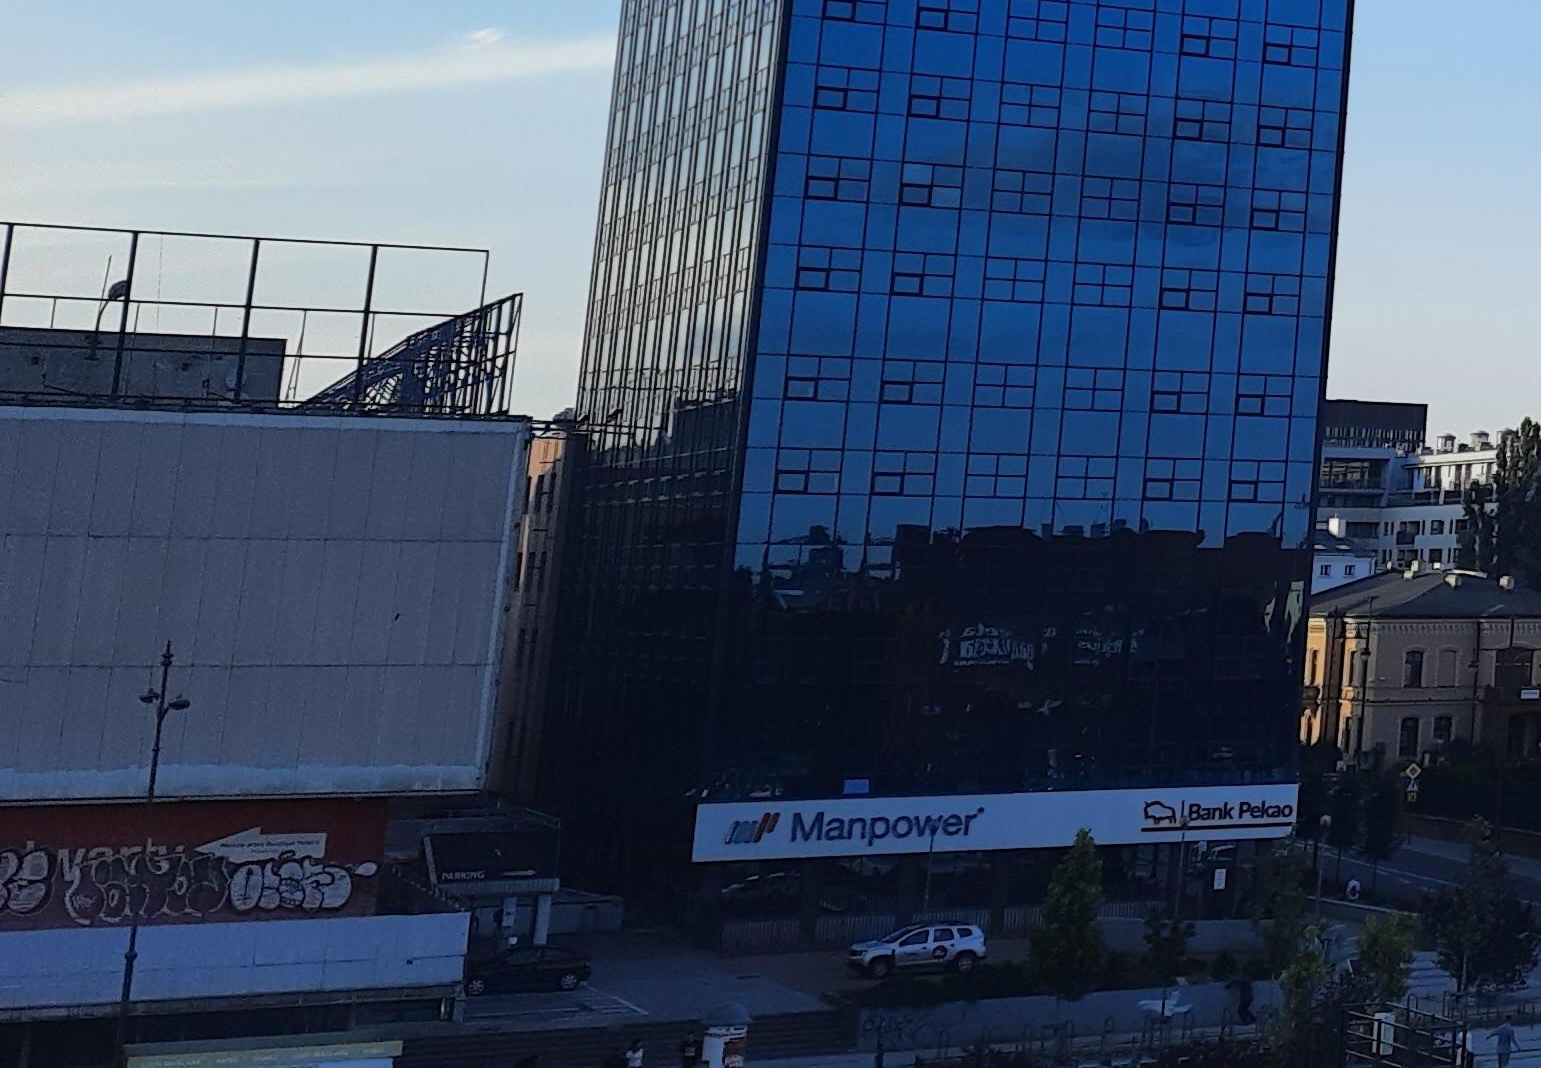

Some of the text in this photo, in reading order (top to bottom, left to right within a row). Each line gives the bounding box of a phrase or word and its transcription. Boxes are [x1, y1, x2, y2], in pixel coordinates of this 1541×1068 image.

[1188, 799, 1294, 822] Bank Pekao
[790, 810, 979, 847] Manpower
[441, 869, 487, 881] PARKING
